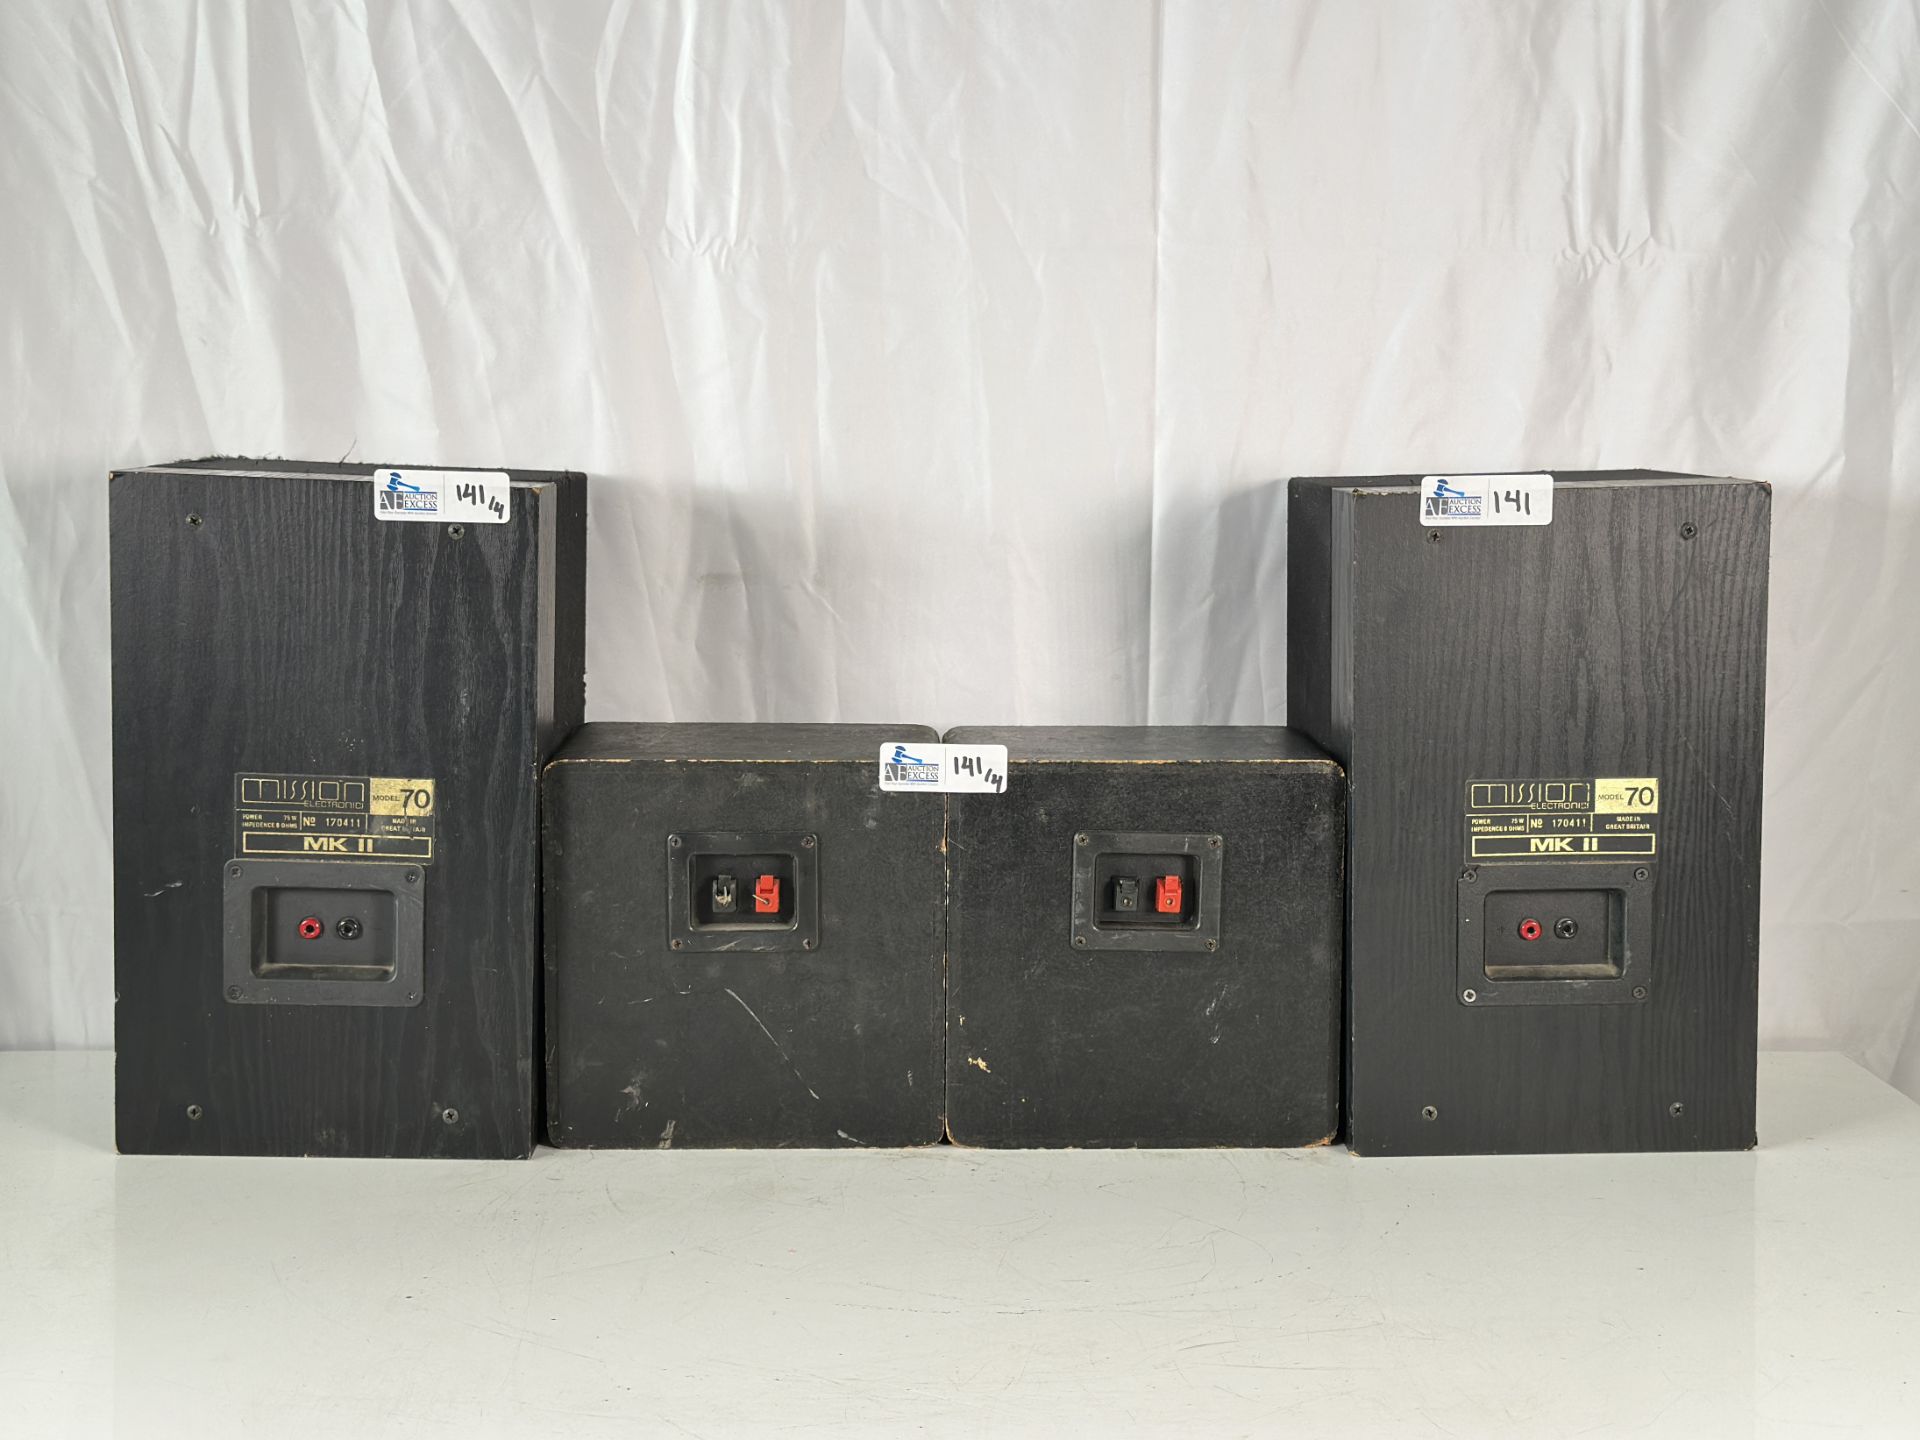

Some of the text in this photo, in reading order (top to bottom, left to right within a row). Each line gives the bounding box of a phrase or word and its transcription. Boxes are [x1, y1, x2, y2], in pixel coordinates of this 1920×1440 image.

[405, 493, 438, 501] AUCTION
[1494, 490, 1531, 515] 141
[405, 500, 438, 509] EXCESS
[1449, 505, 1482, 514] EXCESS
[907, 772, 939, 780] EXCESS
[400, 789, 431, 808] 70
[1625, 787, 1654, 806] 70
[325, 817, 361, 828] 170411
[1552, 818, 1586, 829] 170411
[303, 836, 374, 852] MK II
[1530, 837, 1598, 852] MK II
